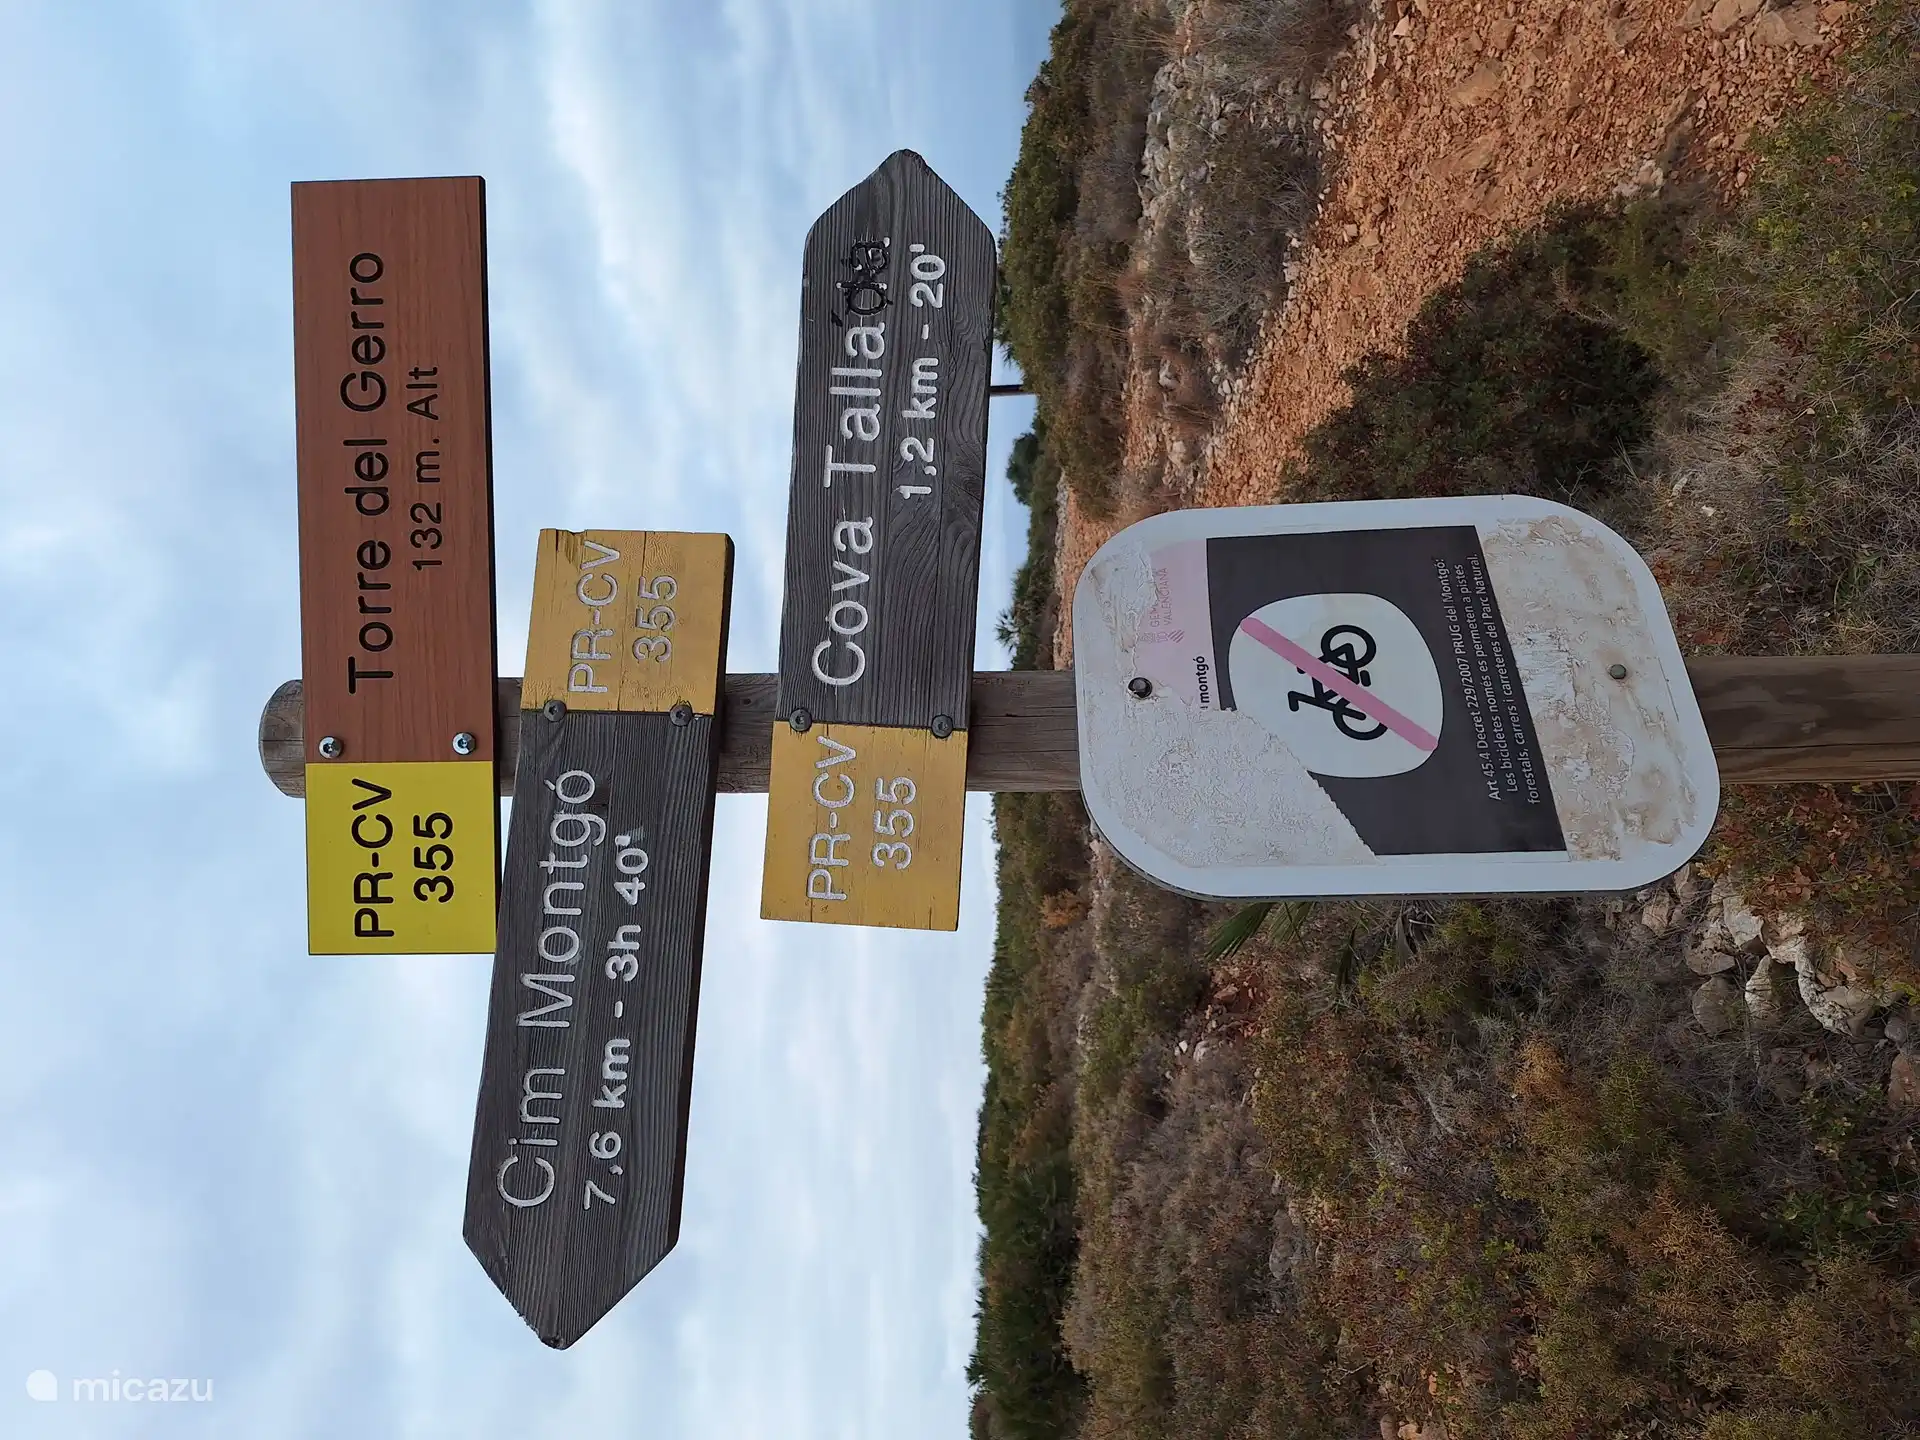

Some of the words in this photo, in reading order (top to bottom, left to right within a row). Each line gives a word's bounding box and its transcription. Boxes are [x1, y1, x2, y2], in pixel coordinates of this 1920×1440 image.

[906, 243, 947, 309] 20'
[339, 252, 387, 413] Gerro
[404, 366, 439, 422] Alt
[900, 357, 939, 419] km
[344, 438, 389, 516] del
[412, 438, 441, 484] m.
[899, 438, 937, 501] 1,2
[409, 502, 442, 571] 132
[812, 517, 876, 687] Cova
[1158, 567, 1173, 626] VALENCIANA
[1434, 558, 1455, 603] Montgó:
[1453, 564, 1473, 594] pistes
[1466, 553, 1488, 594] Natural.
[347, 540, 394, 694] Torre
[568, 539, 621, 695] PR-CV
[633, 574, 679, 664] 355
[1443, 605, 1459, 622] del
[1464, 605, 1488, 657] permeten
[1479, 597, 1493, 619] Parc
[1483, 621, 1498, 638] del
[1449, 624, 1467, 654] PRUG
[1478, 659, 1489, 672] es
[1192, 655, 1210, 704] montgó
[1456, 657, 1479, 708] 229/2007
[1480, 675, 1499, 712] només
[1490, 641, 1513, 696] carreteres
[1470, 710, 1489, 749] Decret
[1491, 715, 1513, 769] bicicletes
[1507, 705, 1526, 745] carrers
[1479, 751, 1496, 777] 45.4
[1486, 780, 1501, 800] Art
[1505, 772, 1519, 792] Les
[1516, 748, 1541, 805] forestals,
[806, 734, 857, 902] PR-CV
[870, 775, 918, 871] 355
[350, 776, 396, 939] PR-CV
[411, 811, 454, 905] 355
[614, 834, 650, 906] 40'
[515, 768, 606, 1029] Montgó
[603, 925, 643, 982] 3h
[592, 1038, 632, 1109] km
[496, 1066, 567, 1209] Cim
[582, 1131, 623, 1211] 7,6
